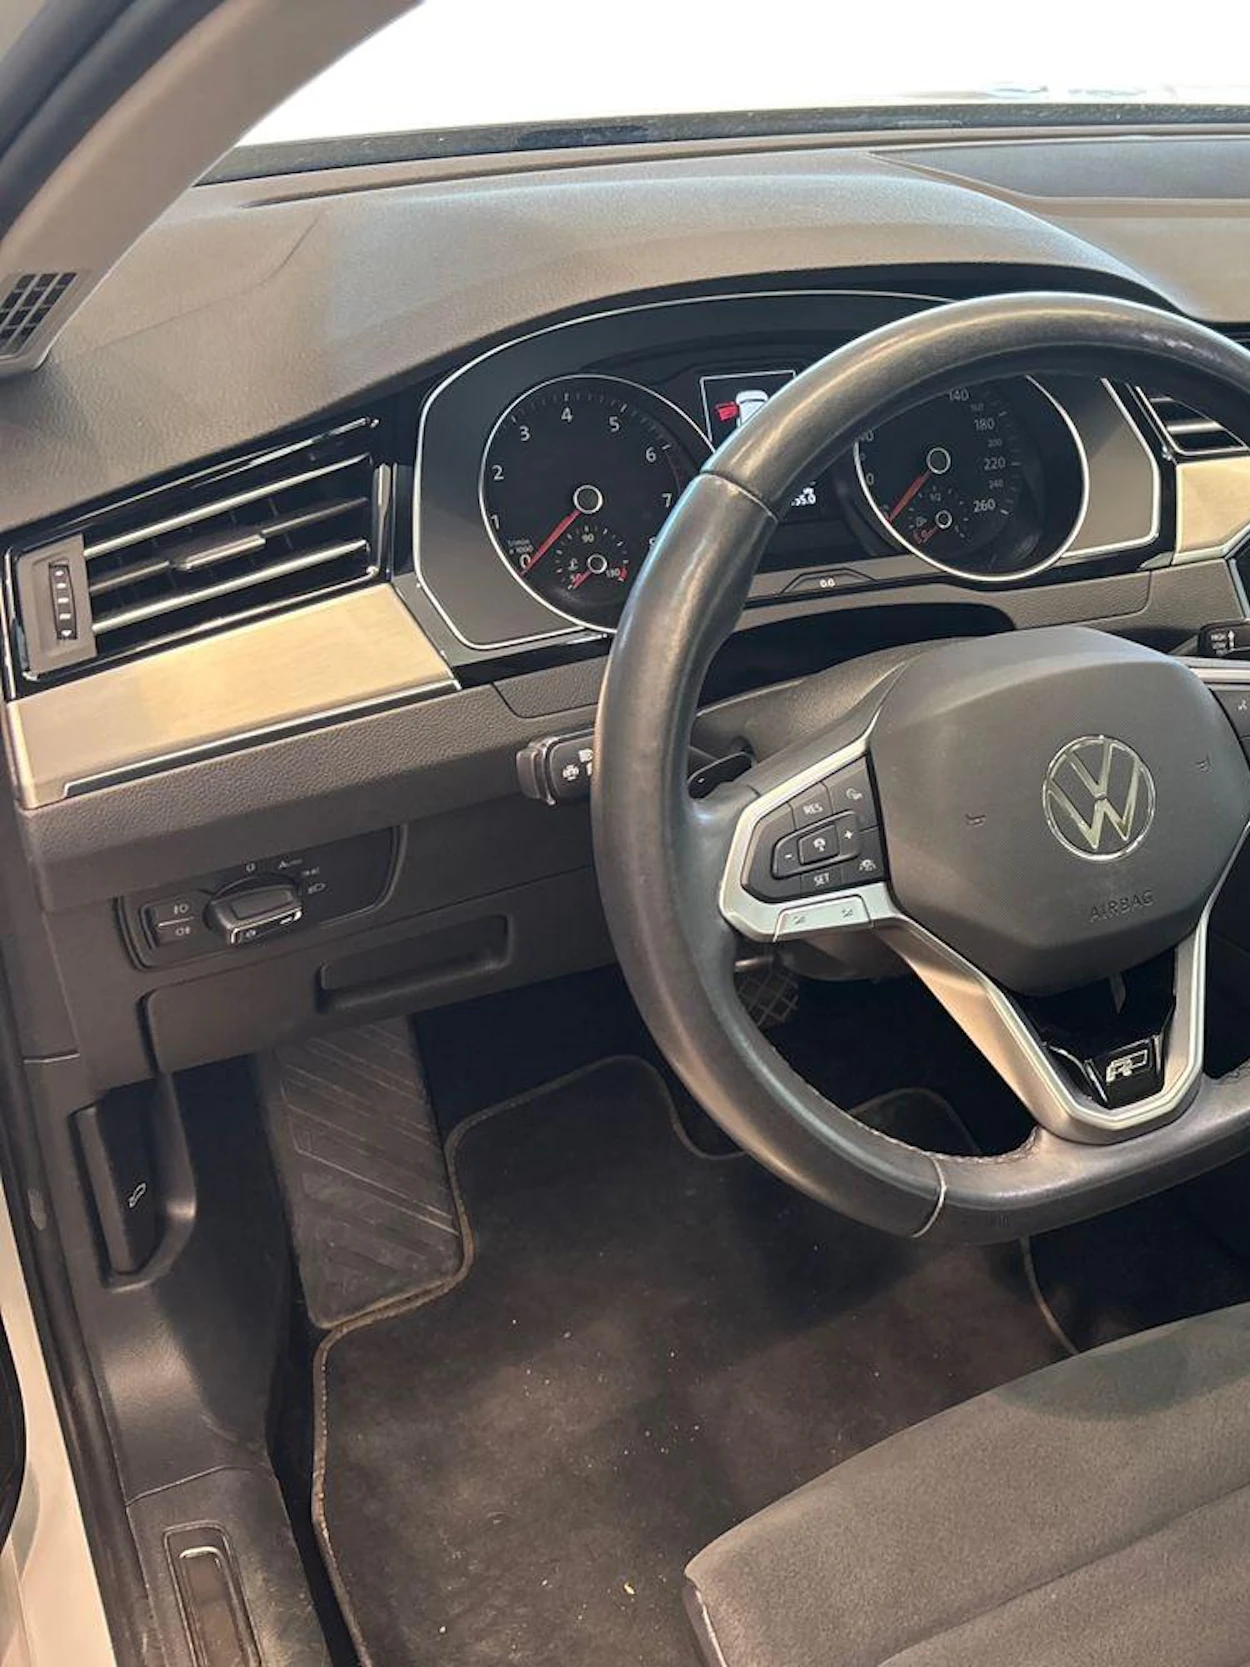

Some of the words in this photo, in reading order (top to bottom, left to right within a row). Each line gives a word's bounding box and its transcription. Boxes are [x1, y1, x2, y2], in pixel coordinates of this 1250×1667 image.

[949, 388, 970, 401] 140
[561, 407, 573, 423] 4
[609, 416, 620, 432] 5
[974, 417, 995, 431] 180
[519, 425, 531, 442] 3
[645, 447, 657, 463] 6
[983, 456, 1006, 470] 220
[492, 464, 504, 480] 2
[662, 492, 672, 508] 7
[973, 499, 996, 513] 260
[491, 514, 500, 529] 1
[581, 534, 594, 544] 90
[519, 554, 532, 569] 0
[802, 803, 824, 816] RES
[813, 872, 831, 886] SET
[1089, 889, 1155, 923] AIRBAG
